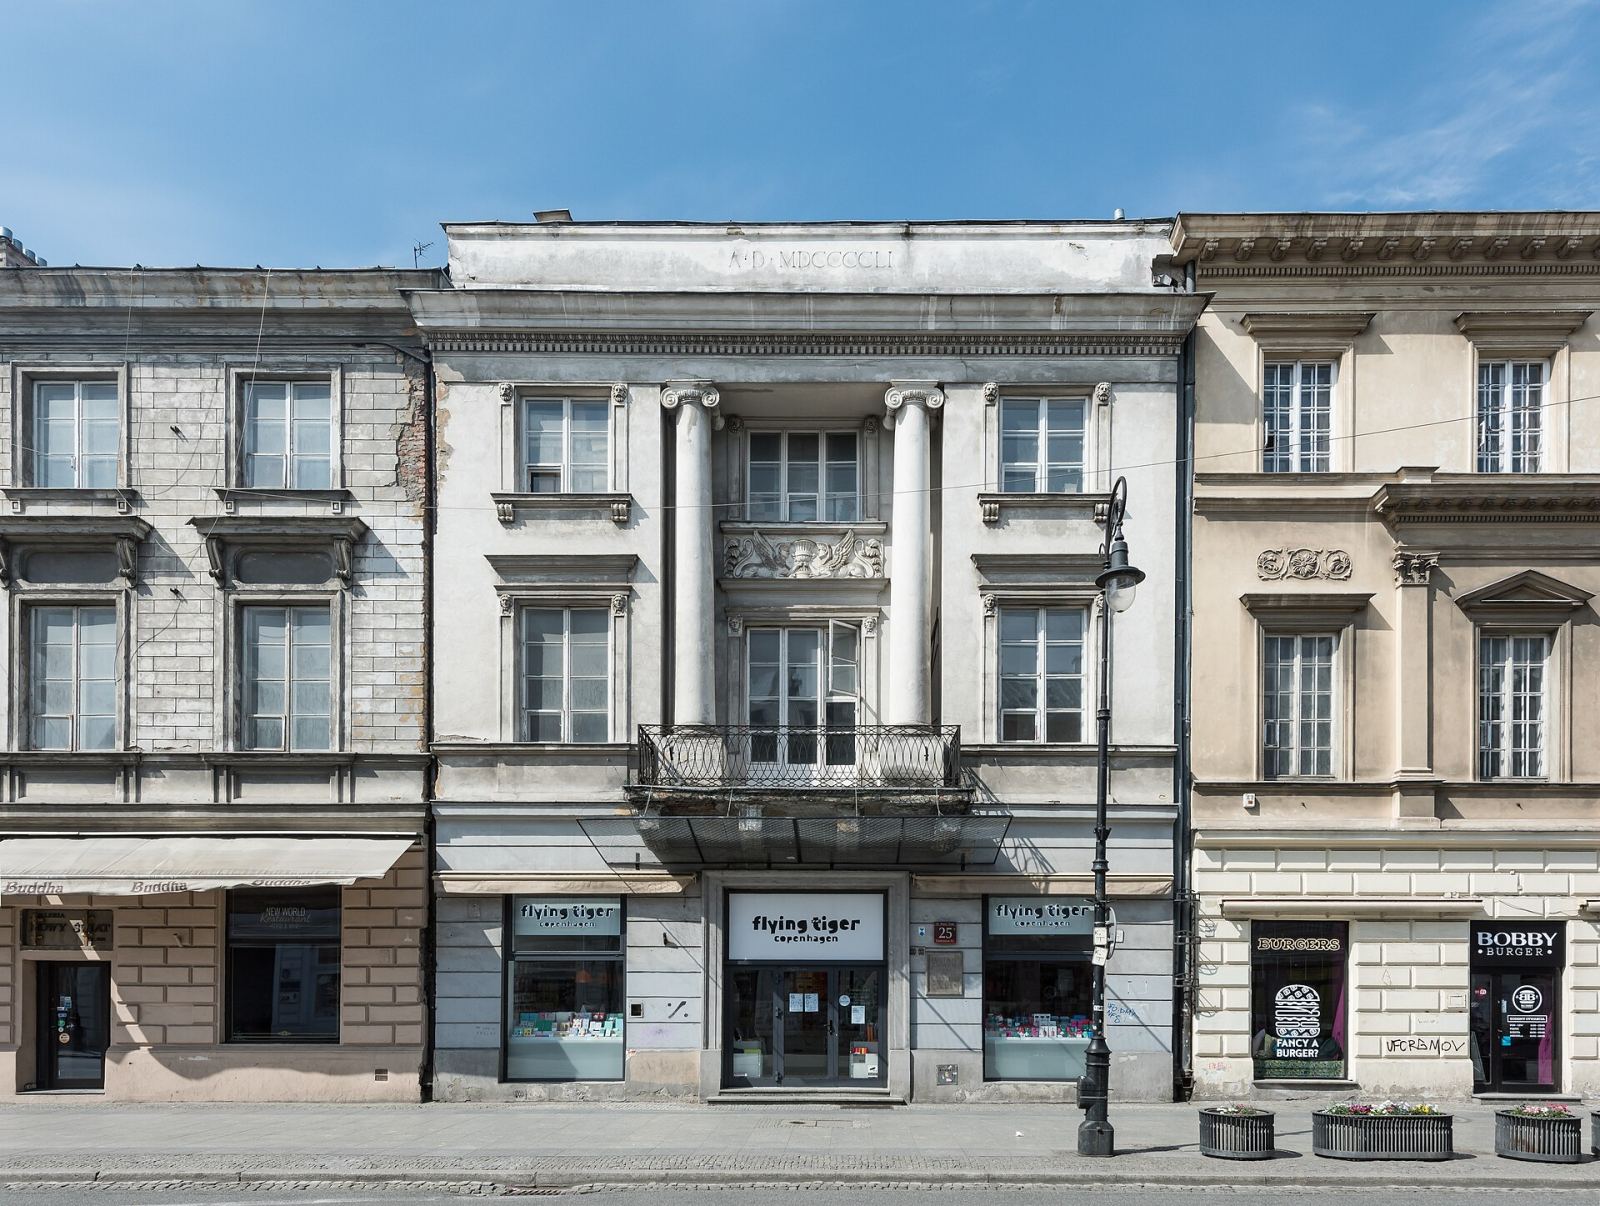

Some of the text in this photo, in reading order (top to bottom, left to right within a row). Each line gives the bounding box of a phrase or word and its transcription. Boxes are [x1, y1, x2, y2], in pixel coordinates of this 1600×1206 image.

[4, 881, 64, 895] Buddha
[131, 881, 188, 893] Buddha
[520, 904, 614, 920] flying tiger
[995, 904, 1089, 920] flying tiger
[540, 921, 596, 929] copenhagen
[752, 915, 860, 934] flying tiger
[938, 927, 952, 939] 25
[773, 935, 838, 944] copenhagen
[1257, 938, 1340, 951] BURGERS
[1477, 932, 1557, 947] BOBBY
[1486, 948, 1544, 956] BURGER
[1276, 1039, 1319, 1048] FANCY A
[1276, 1049, 1319, 1058] BURGER?
